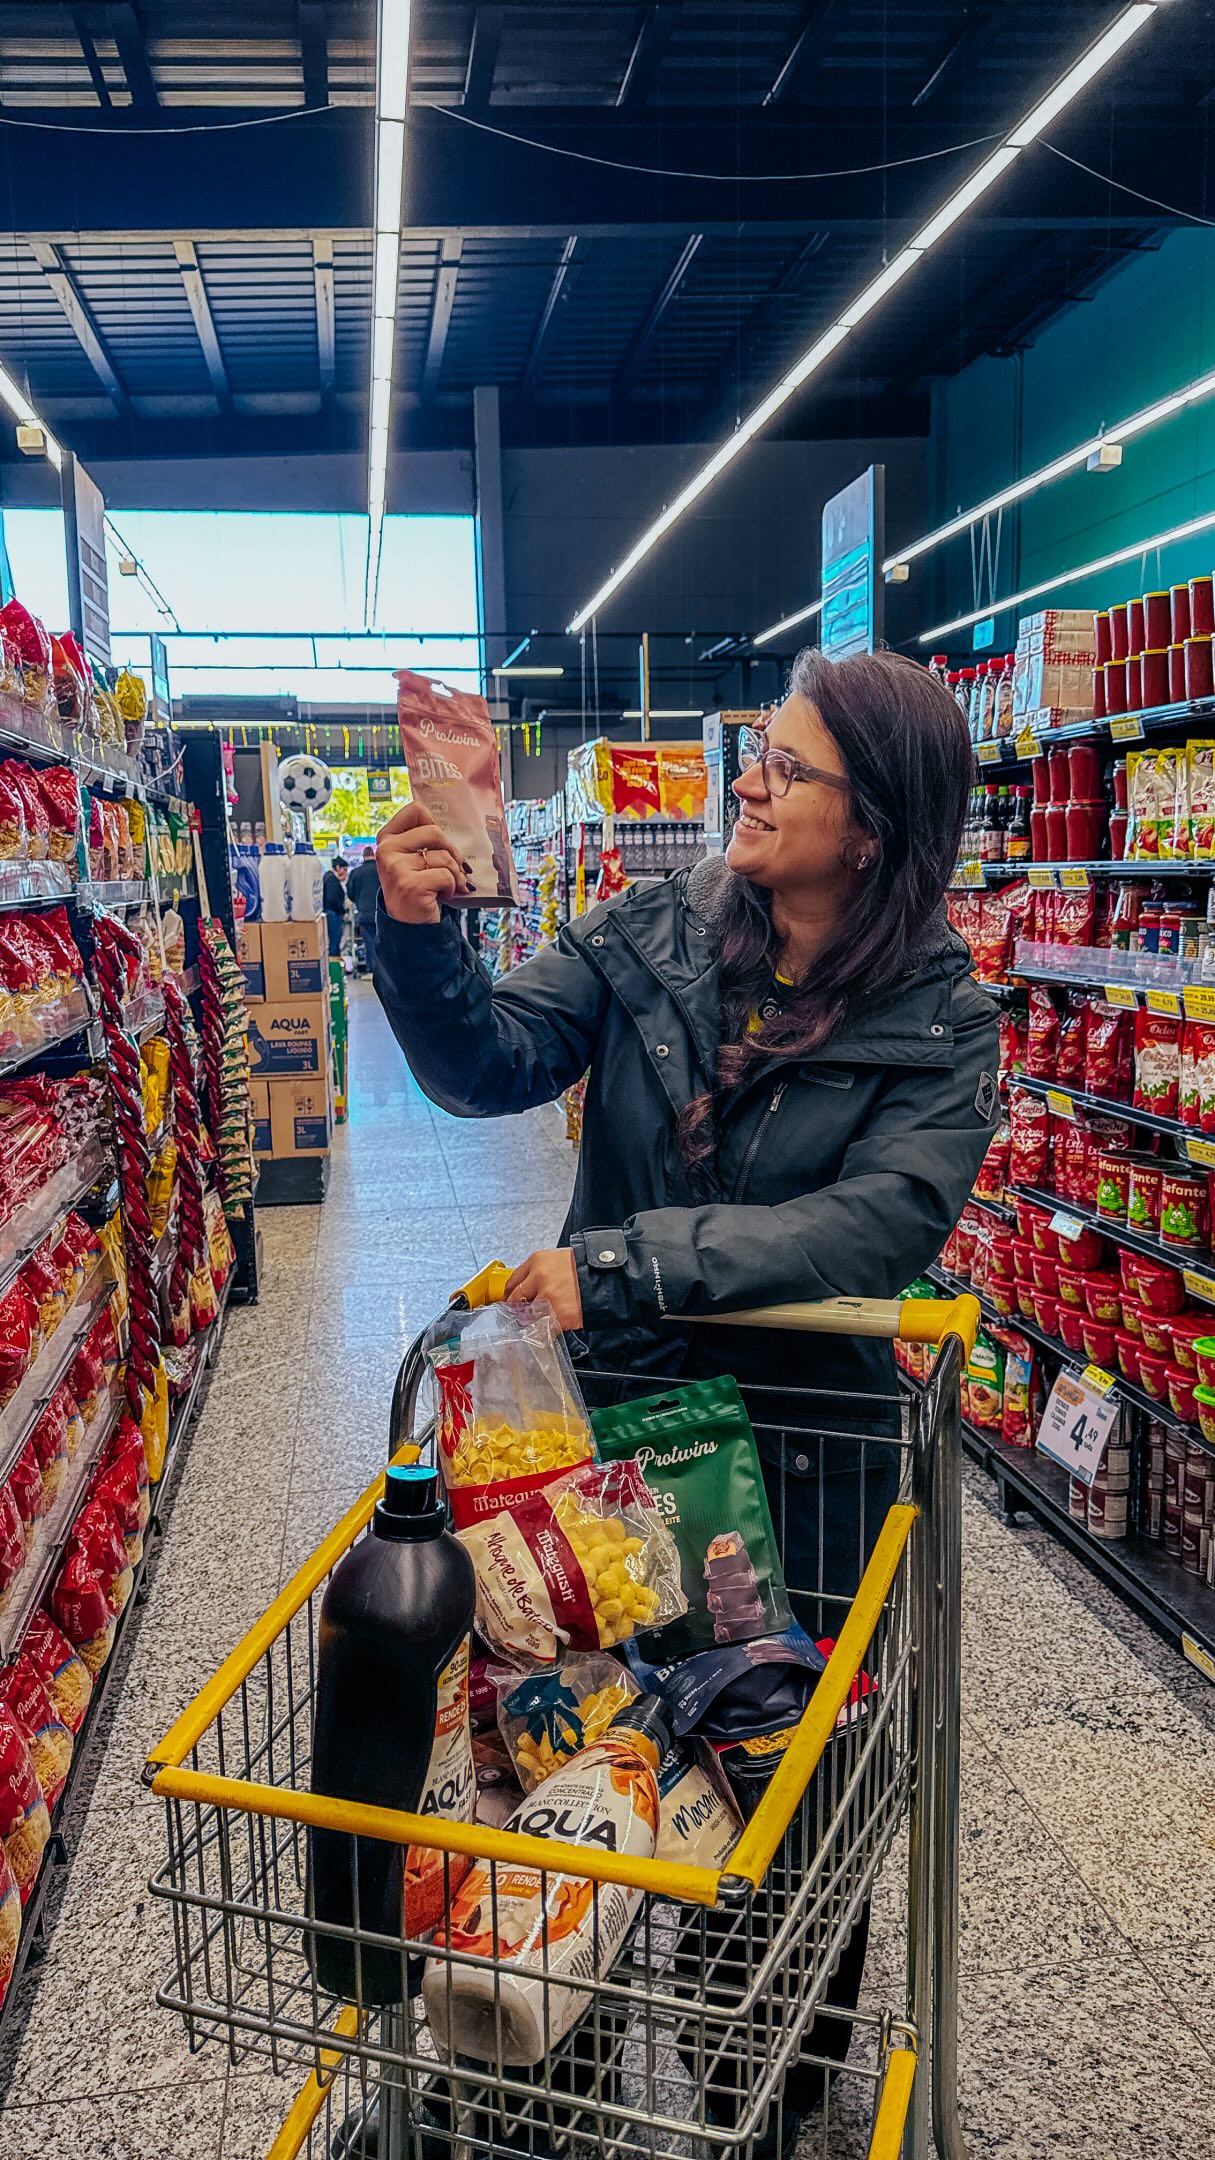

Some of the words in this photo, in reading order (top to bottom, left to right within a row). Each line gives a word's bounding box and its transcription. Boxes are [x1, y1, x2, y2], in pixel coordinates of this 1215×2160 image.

[420, 718, 480, 747] Protwins
[417, 758, 463, 780] BITES
[270, 1018, 311, 1031] AQUA
[302, 1061, 312, 1070] 3L
[1069, 1413, 1088, 1452] 4
[635, 1440, 719, 1472] Protwins
[506, 1577, 528, 1598] de
[72, 1601, 83, 1636] Parati
[450, 1660, 459, 1674] 90
[420, 1758, 473, 1815] AQUA
[502, 1808, 617, 1852] AQUA
